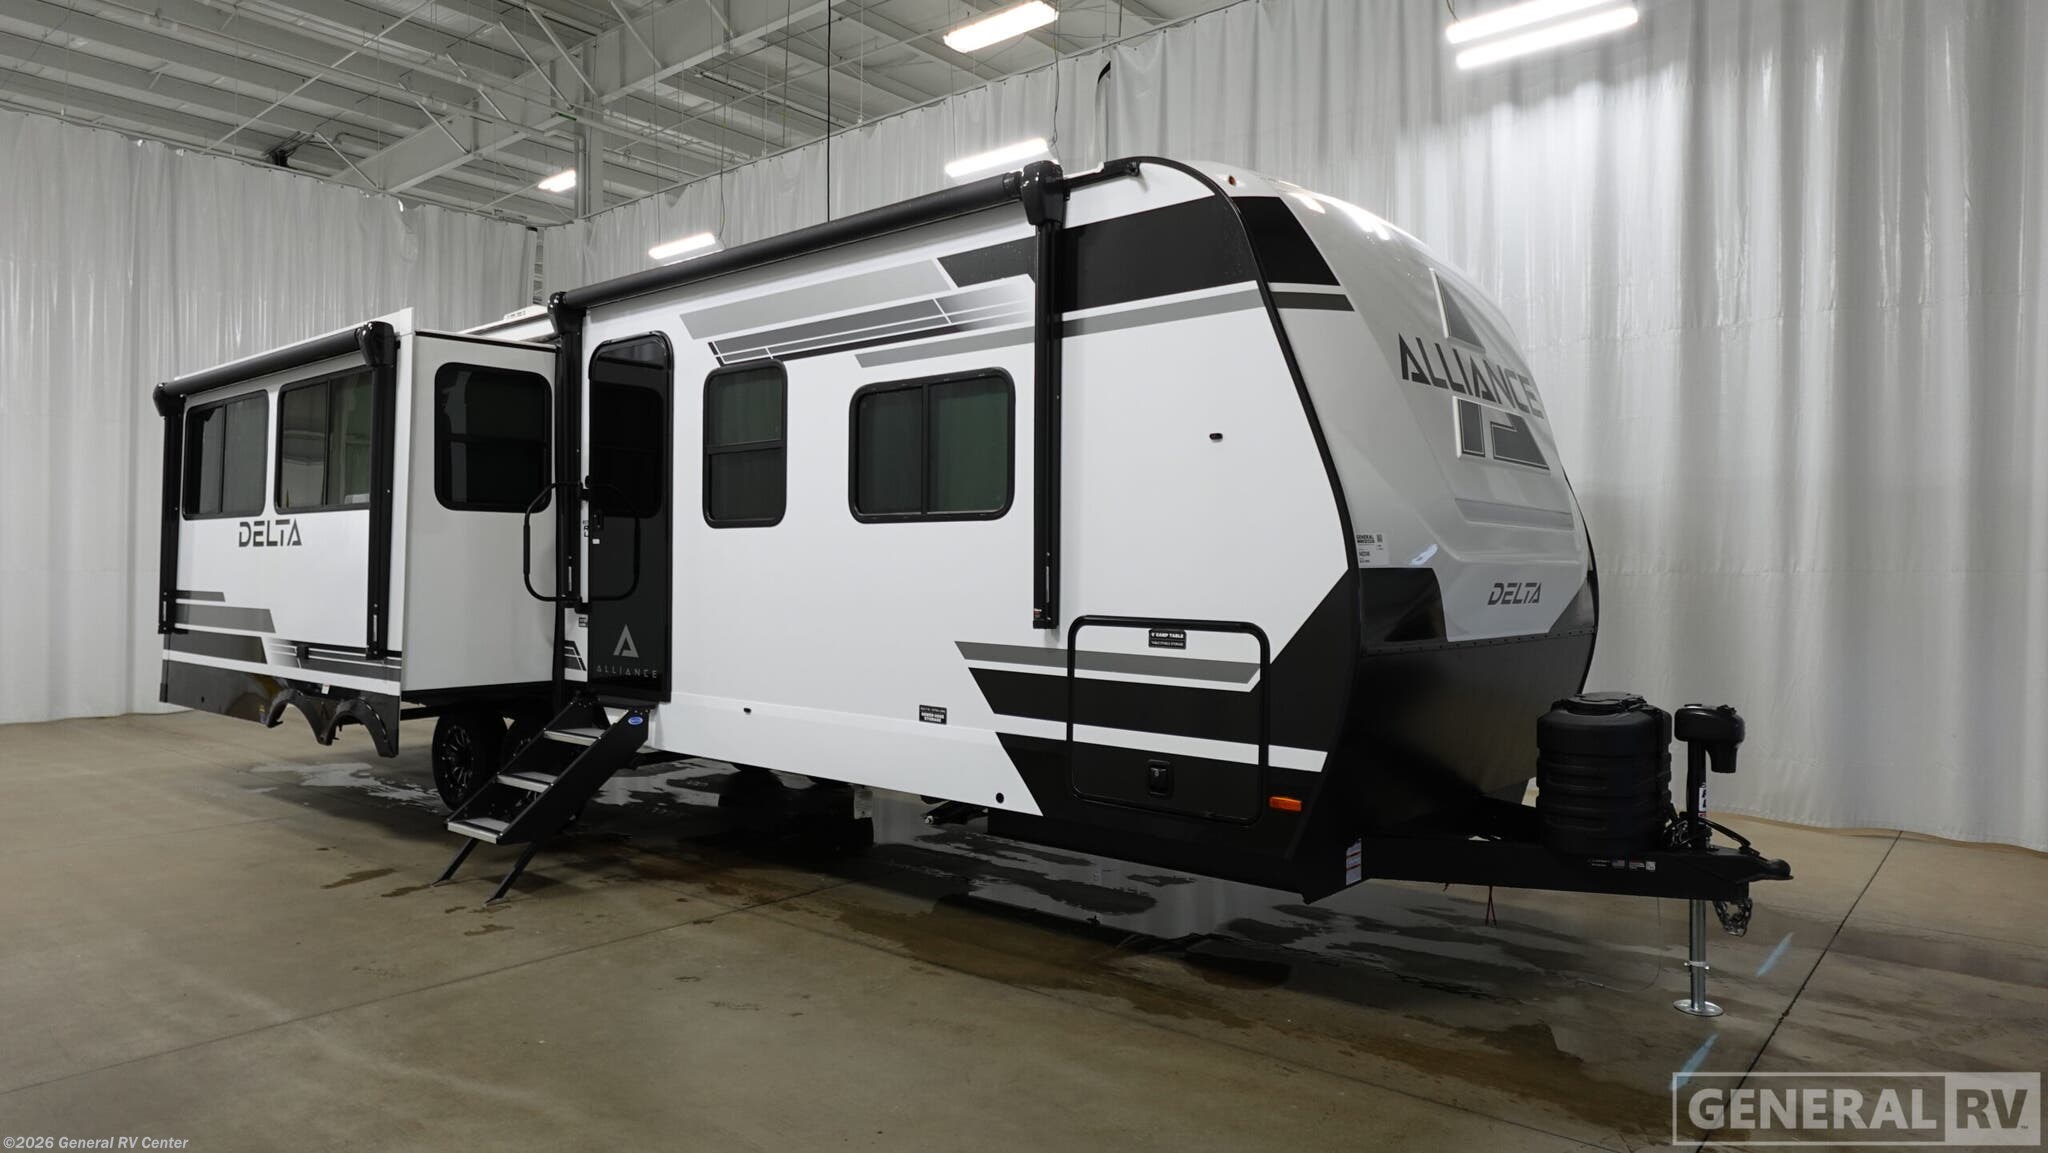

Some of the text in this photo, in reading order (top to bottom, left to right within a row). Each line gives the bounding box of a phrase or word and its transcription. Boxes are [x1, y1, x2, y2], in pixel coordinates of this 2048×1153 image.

[1398, 332, 1545, 419] ALLIANCE
[239, 518, 302, 547] DELTA
[1487, 582, 1542, 606] DELTA
[596, 665, 657, 679] ALLIANCE
